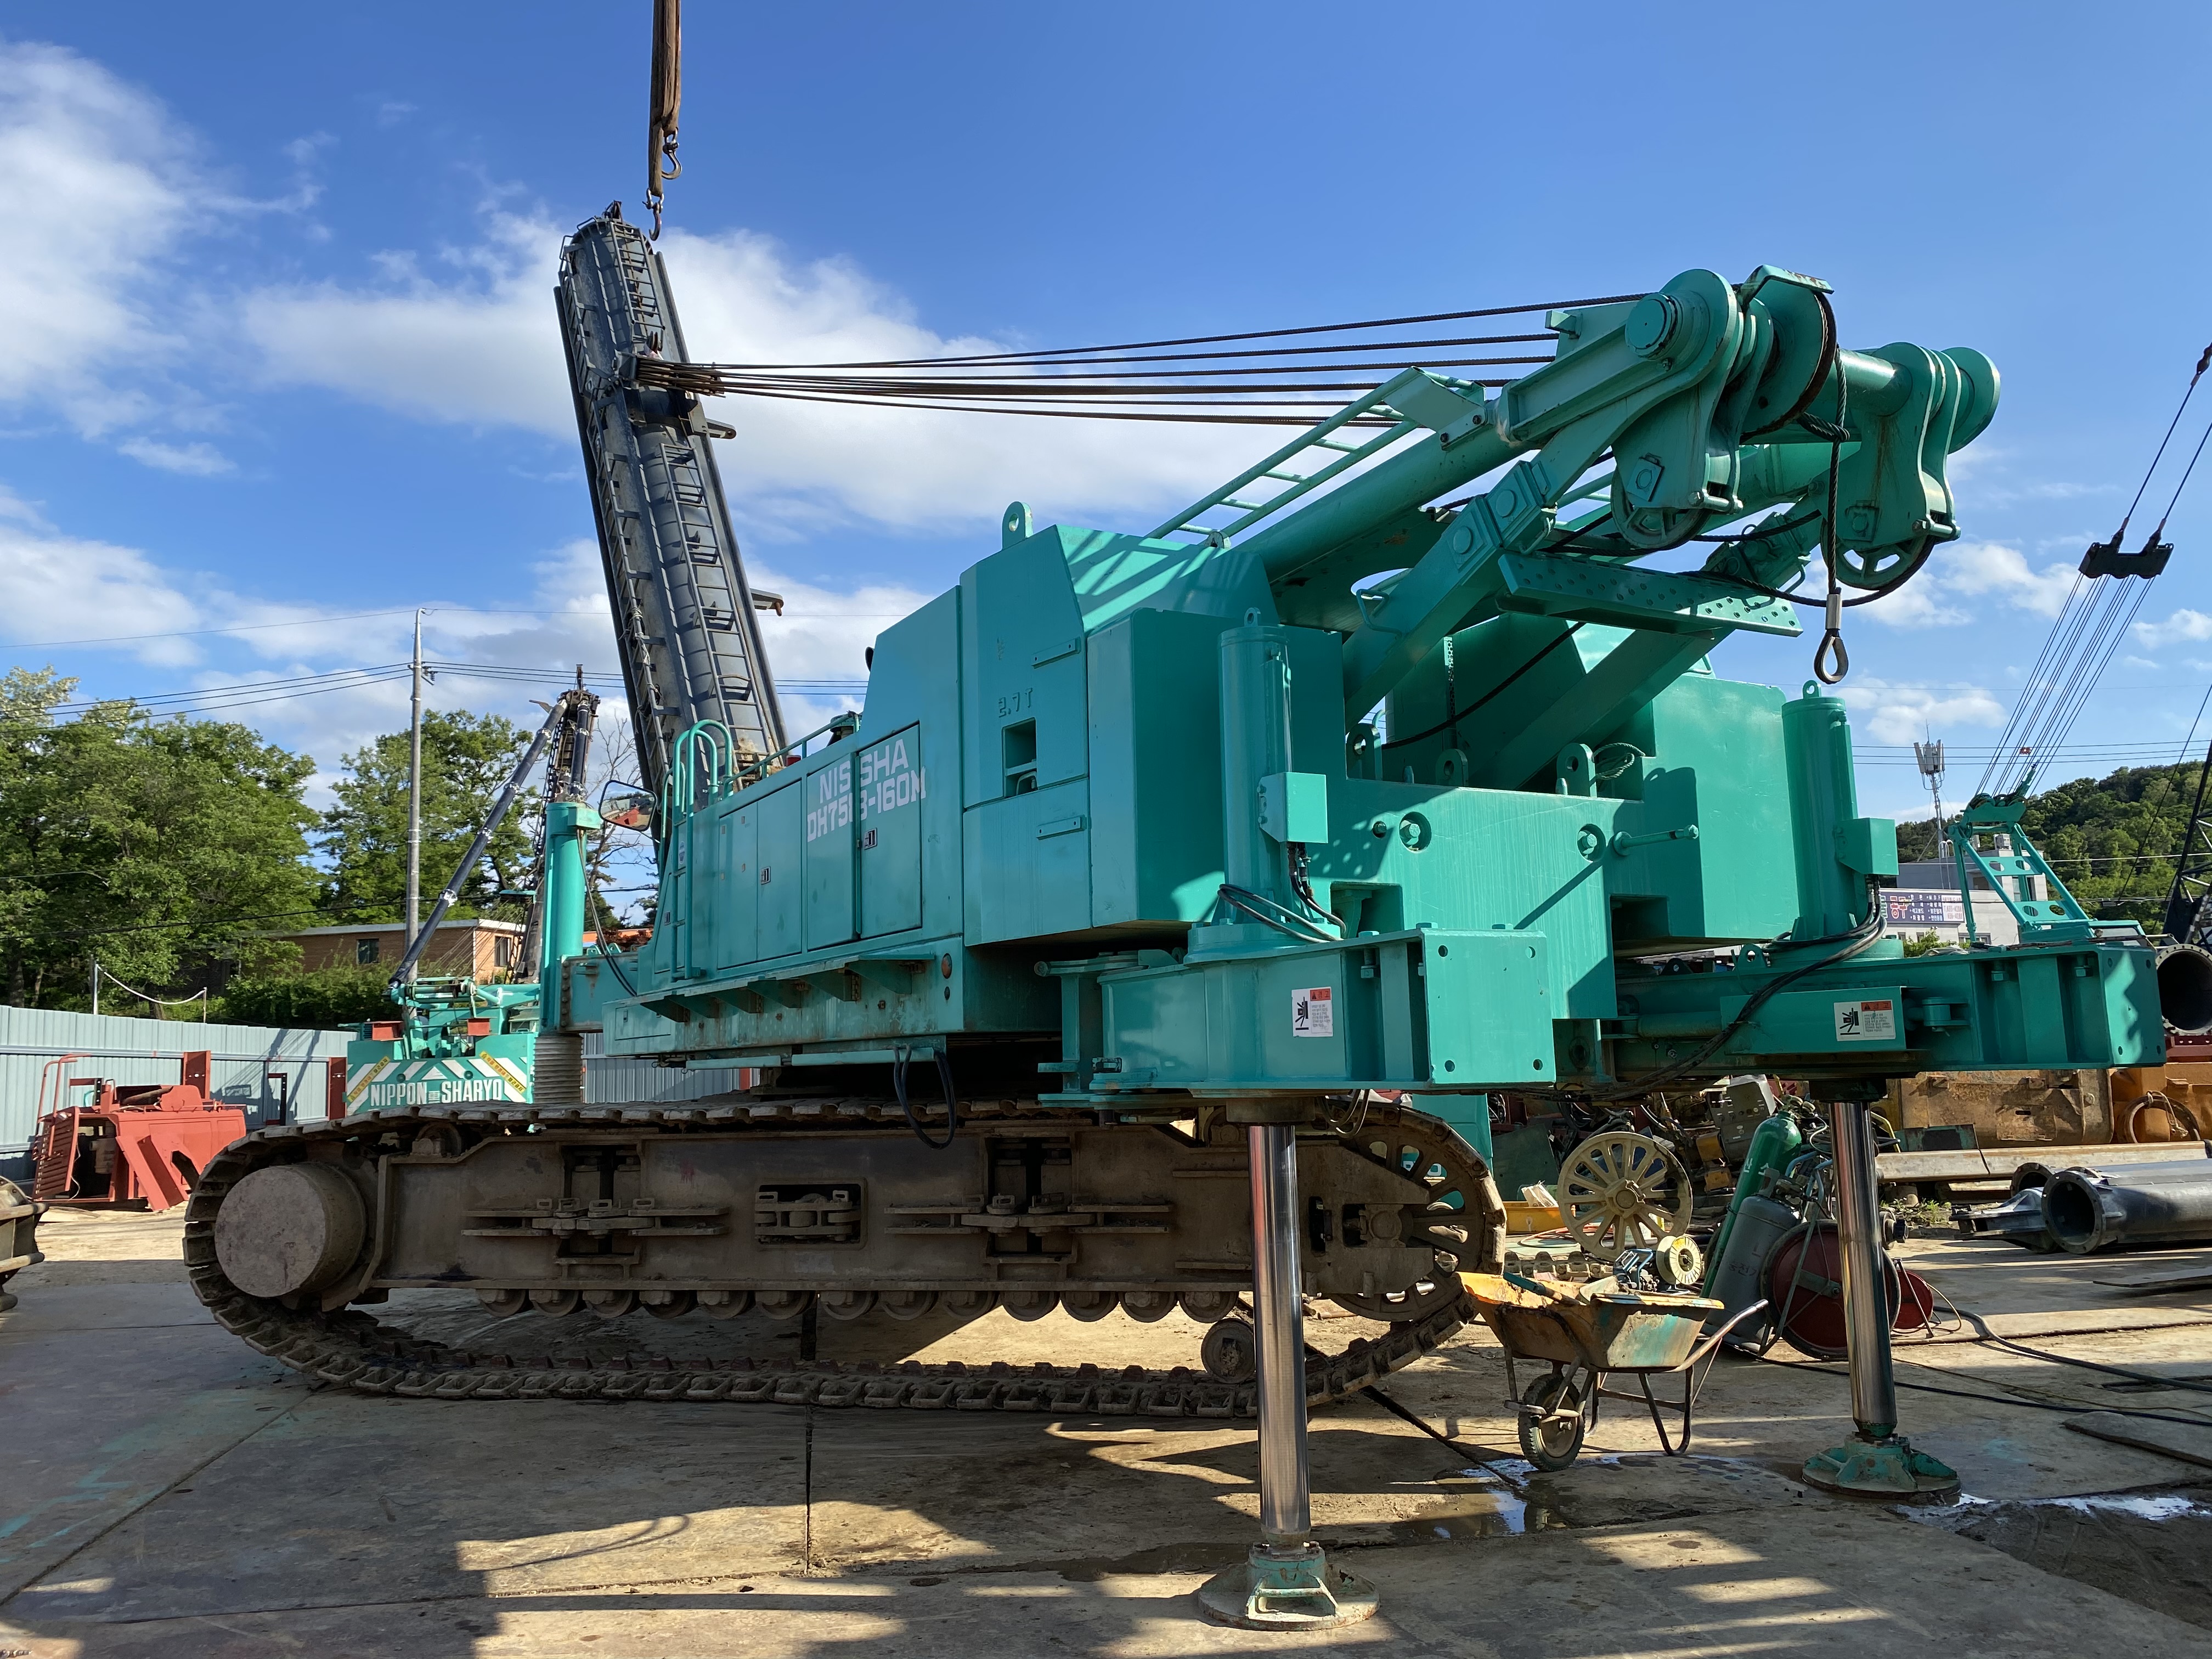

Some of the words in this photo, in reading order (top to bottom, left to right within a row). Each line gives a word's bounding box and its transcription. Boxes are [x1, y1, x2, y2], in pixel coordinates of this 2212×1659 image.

[819, 738, 909, 804] NISSHA
[370, 1082, 427, 1106] NIPPON
[441, 1079, 503, 1104] SHARYO
